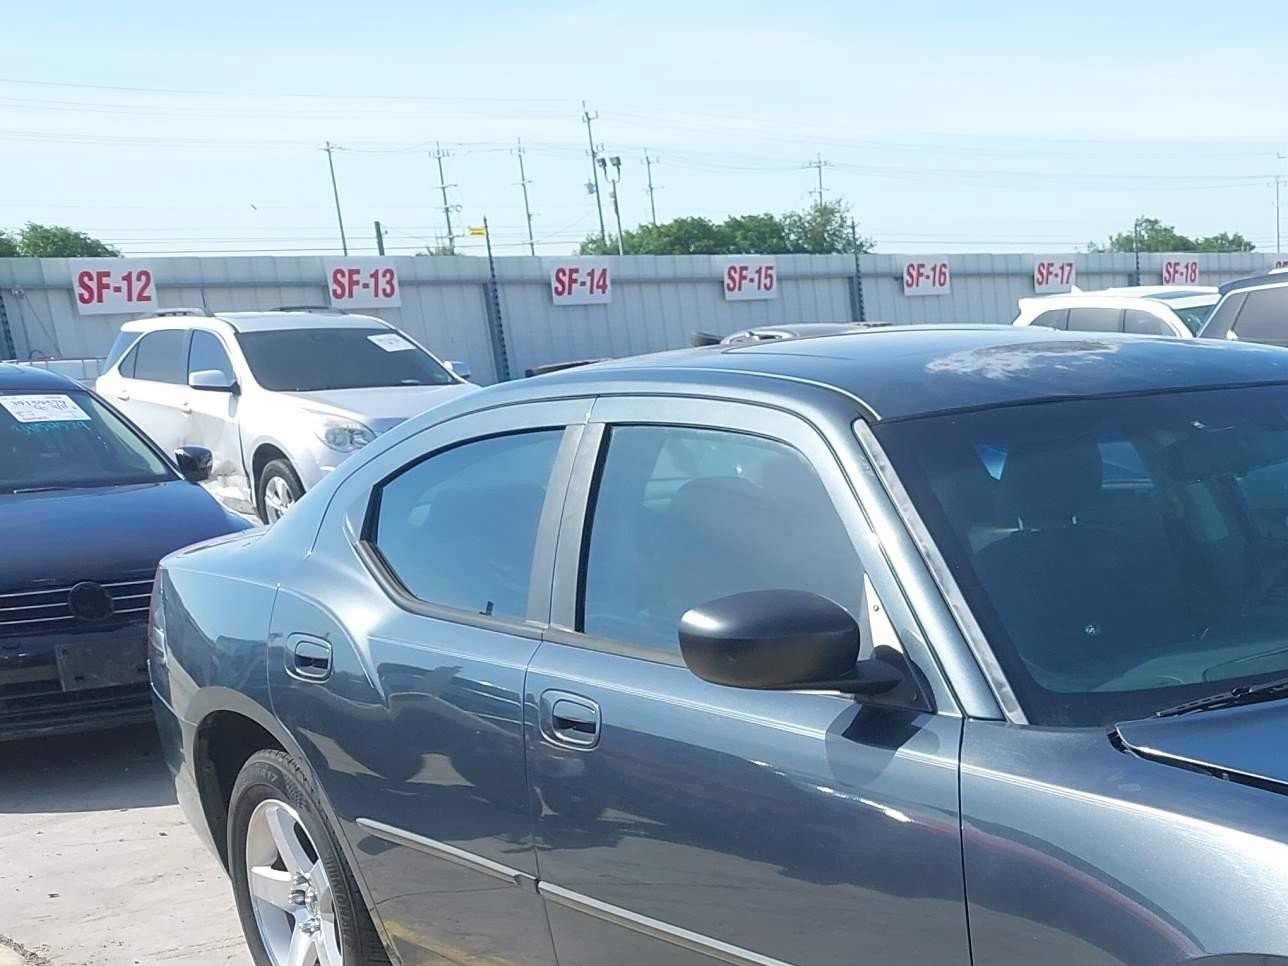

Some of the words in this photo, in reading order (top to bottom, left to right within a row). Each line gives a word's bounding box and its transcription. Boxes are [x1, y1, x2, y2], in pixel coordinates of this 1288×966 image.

[331, 268, 396, 300] SF-13
[553, 268, 608, 297] SF-14
[726, 265, 774, 292] SF-15
[905, 263, 948, 289] SF-16
[1036, 262, 1074, 286] SF-17
[1164, 261, 1198, 284] SF-18
[78, 271, 152, 305] SF-12
